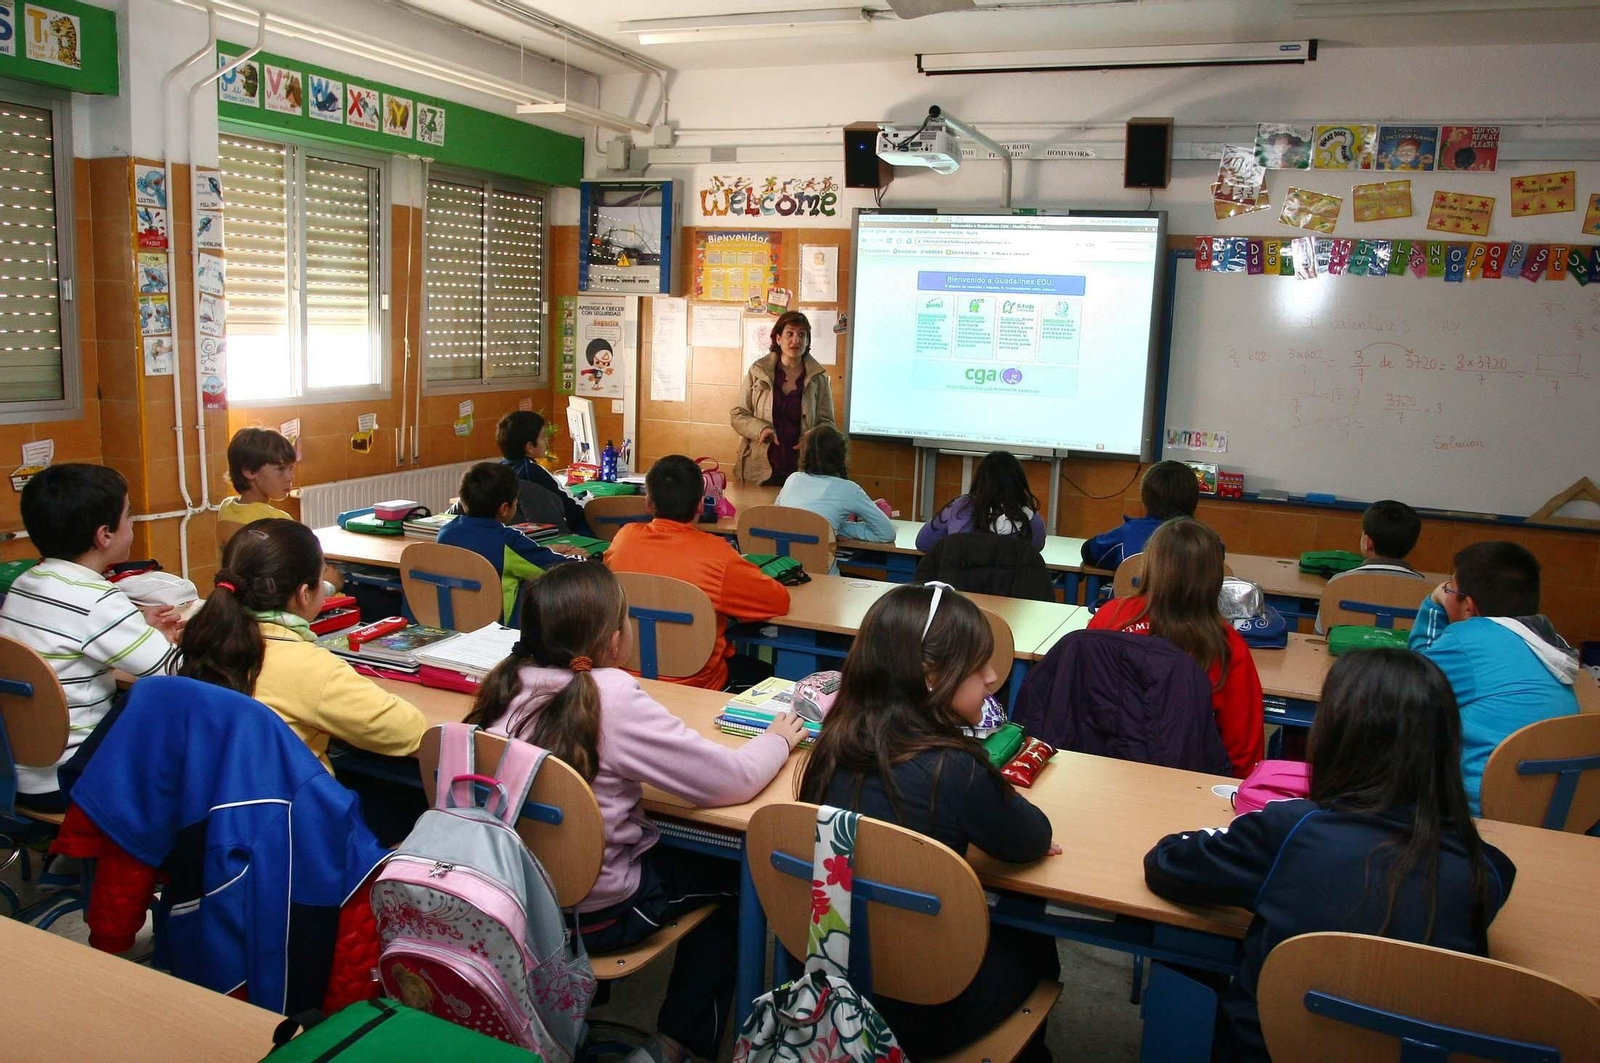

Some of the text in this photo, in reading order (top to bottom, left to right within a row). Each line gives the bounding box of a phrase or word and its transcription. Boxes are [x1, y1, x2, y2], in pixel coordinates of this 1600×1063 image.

[27, 8, 48, 43] T
[266, 67, 283, 96] V
[349, 89, 363, 118] X
[392, 98, 406, 127] Y
[1198, 240, 1208, 251] A
[1250, 243, 1260, 256] D
[1268, 242, 1278, 255] E
[1397, 242, 1405, 254] L
[1431, 244, 1441, 256] N
[1451, 249, 1462, 261] O
[1474, 246, 1486, 258] P
[1490, 245, 1501, 259] Q
[1511, 244, 1523, 258] R
[1536, 248, 1548, 262] S
[1554, 247, 1567, 258] T
[947, 275, 985, 285] Bienvenido
[994, 277, 1035, 286] Guadalinex
[965, 368, 997, 386] cga
